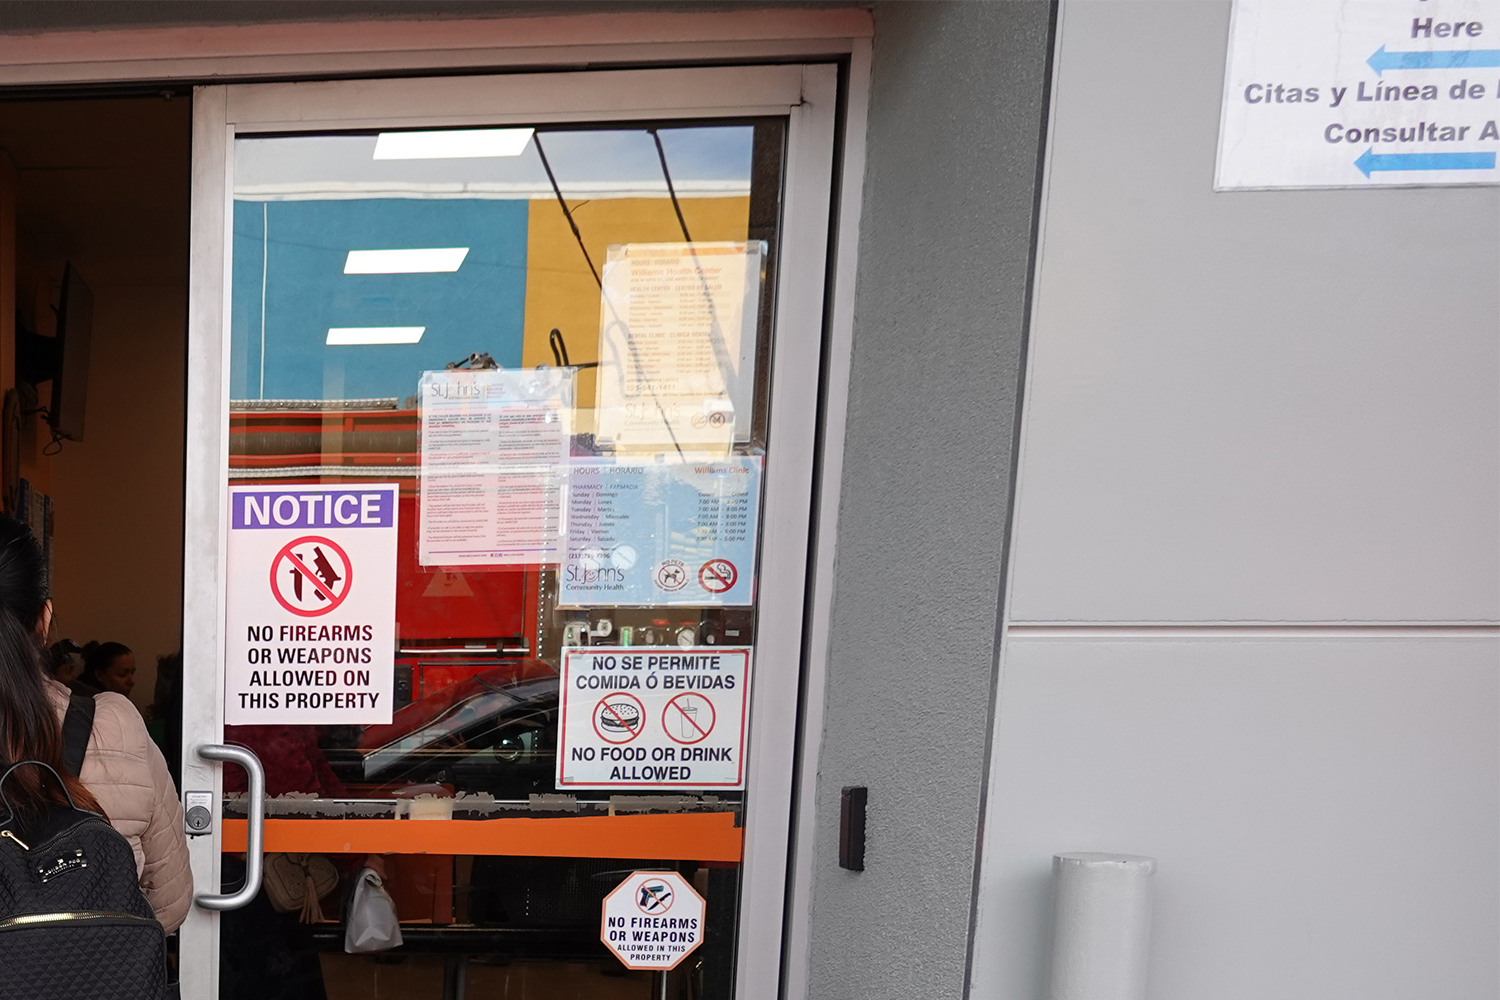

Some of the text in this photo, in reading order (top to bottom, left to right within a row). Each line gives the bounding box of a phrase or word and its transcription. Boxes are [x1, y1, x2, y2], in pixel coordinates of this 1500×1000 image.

[1411, 18, 1483, 38] Here
[1244, 84, 1319, 103] Citas
[1329, 87, 1347, 107] y
[1356, 81, 1437, 101] Línea
[1449, 80, 1485, 98] de
[1324, 122, 1470, 143] Consultar
[610, 467, 644, 475] HORARIO
[244, 494, 381, 525] NOTICE
[248, 625, 372, 641] NO FIREARMS
[248, 648, 371, 664] OR WEAPONS
[593, 656, 720, 670] NO SE PERMITE
[250, 670, 369, 686] ALLOWED ON
[576, 672, 735, 689] COMIDA Ó BEVIDAS
[238, 693, 379, 708] THIS PROPERTY
[572, 748, 732, 761] NO FOOD OR DRINK
[610, 767, 691, 780] ALLOWED
[608, 917, 697, 929] NO FIREARMS
[610, 931, 695, 943] OR WEAPONS
